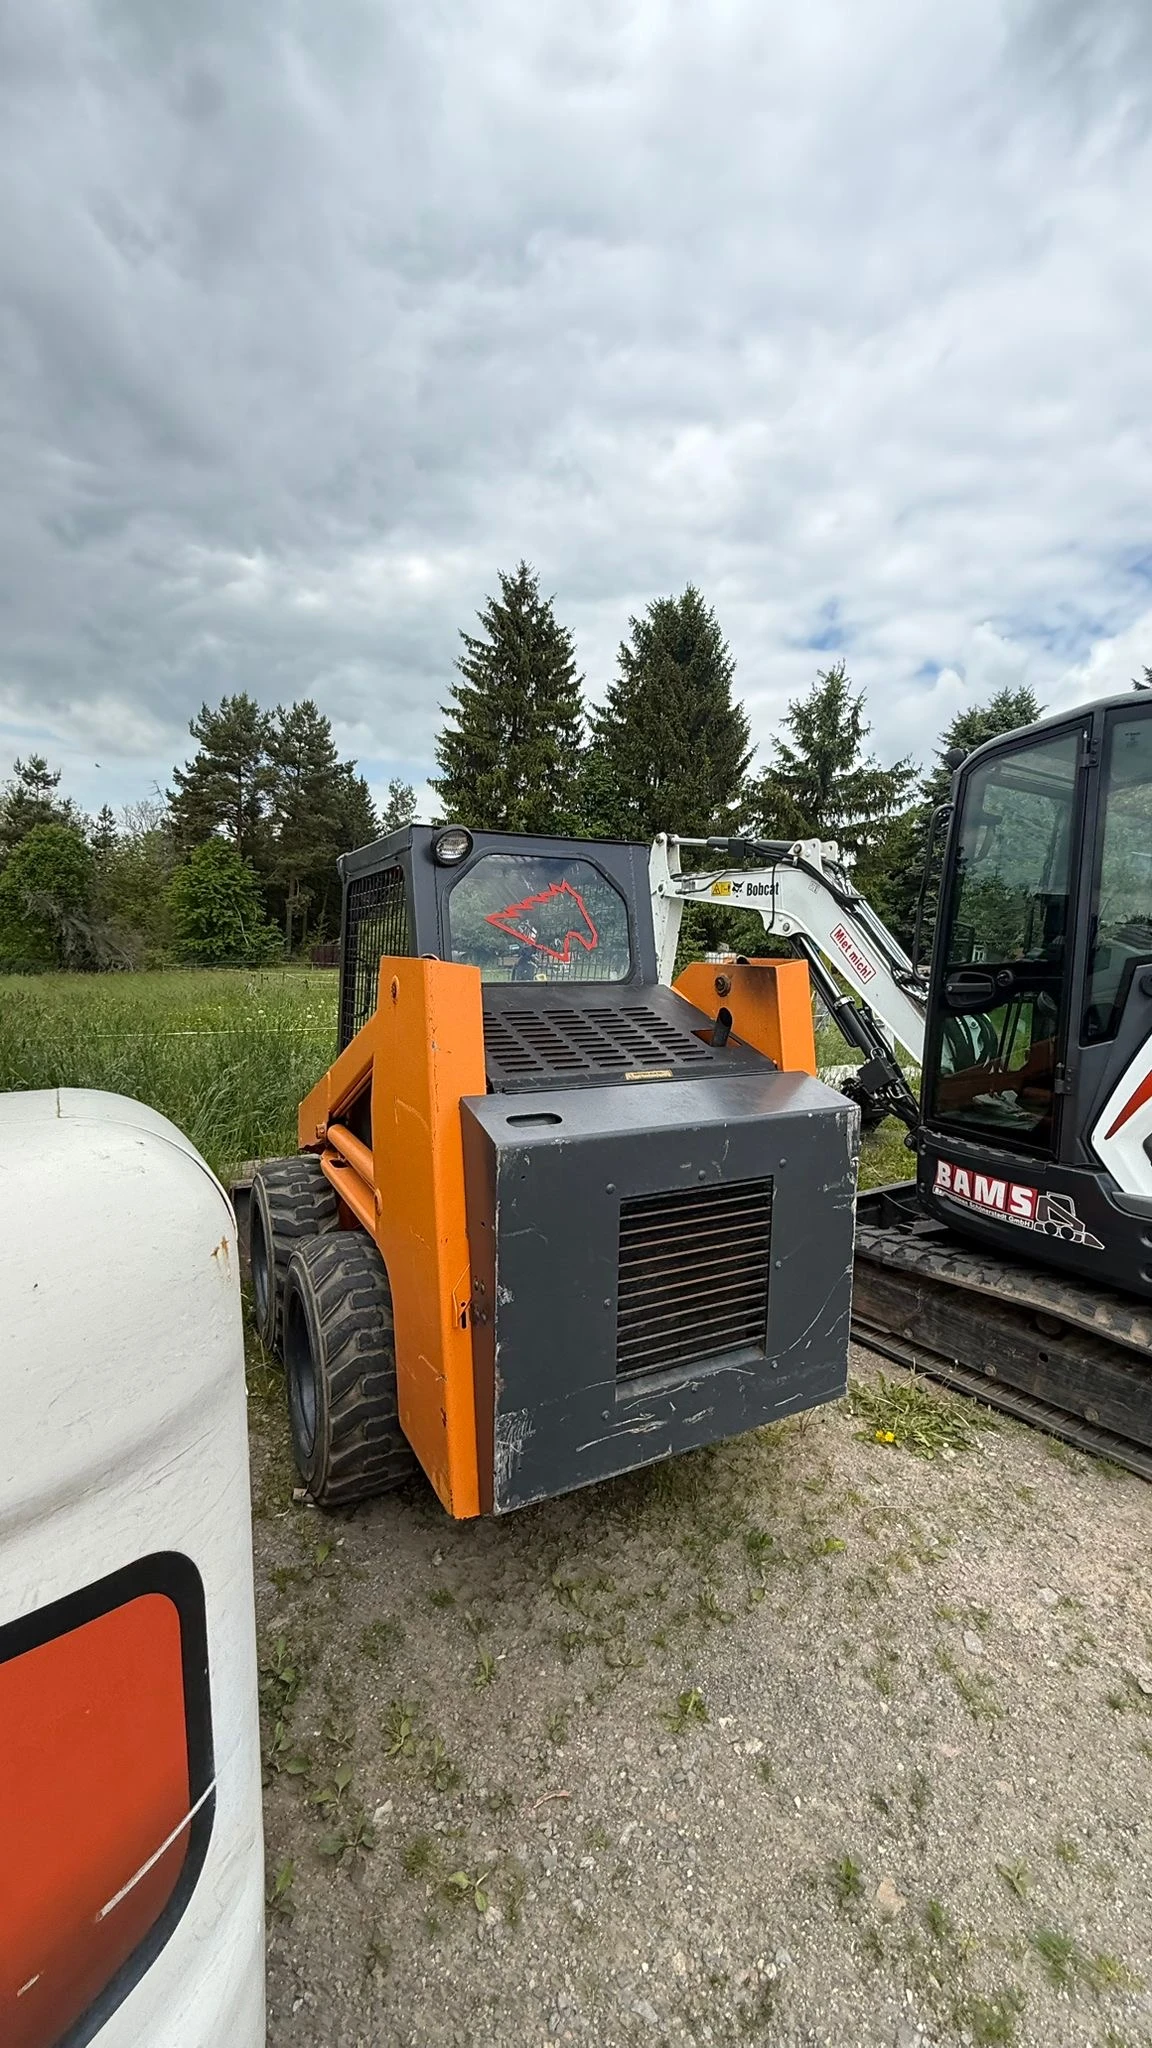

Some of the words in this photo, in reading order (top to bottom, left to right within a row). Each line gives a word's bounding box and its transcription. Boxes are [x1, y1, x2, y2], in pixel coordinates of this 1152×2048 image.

[746, 882, 779, 896] Bobcat
[834, 929, 852, 953] Miet
[849, 951, 872, 979] mich!
[937, 1160, 1033, 1217] BAMS
[1009, 1215, 1030, 1227] GmbH
